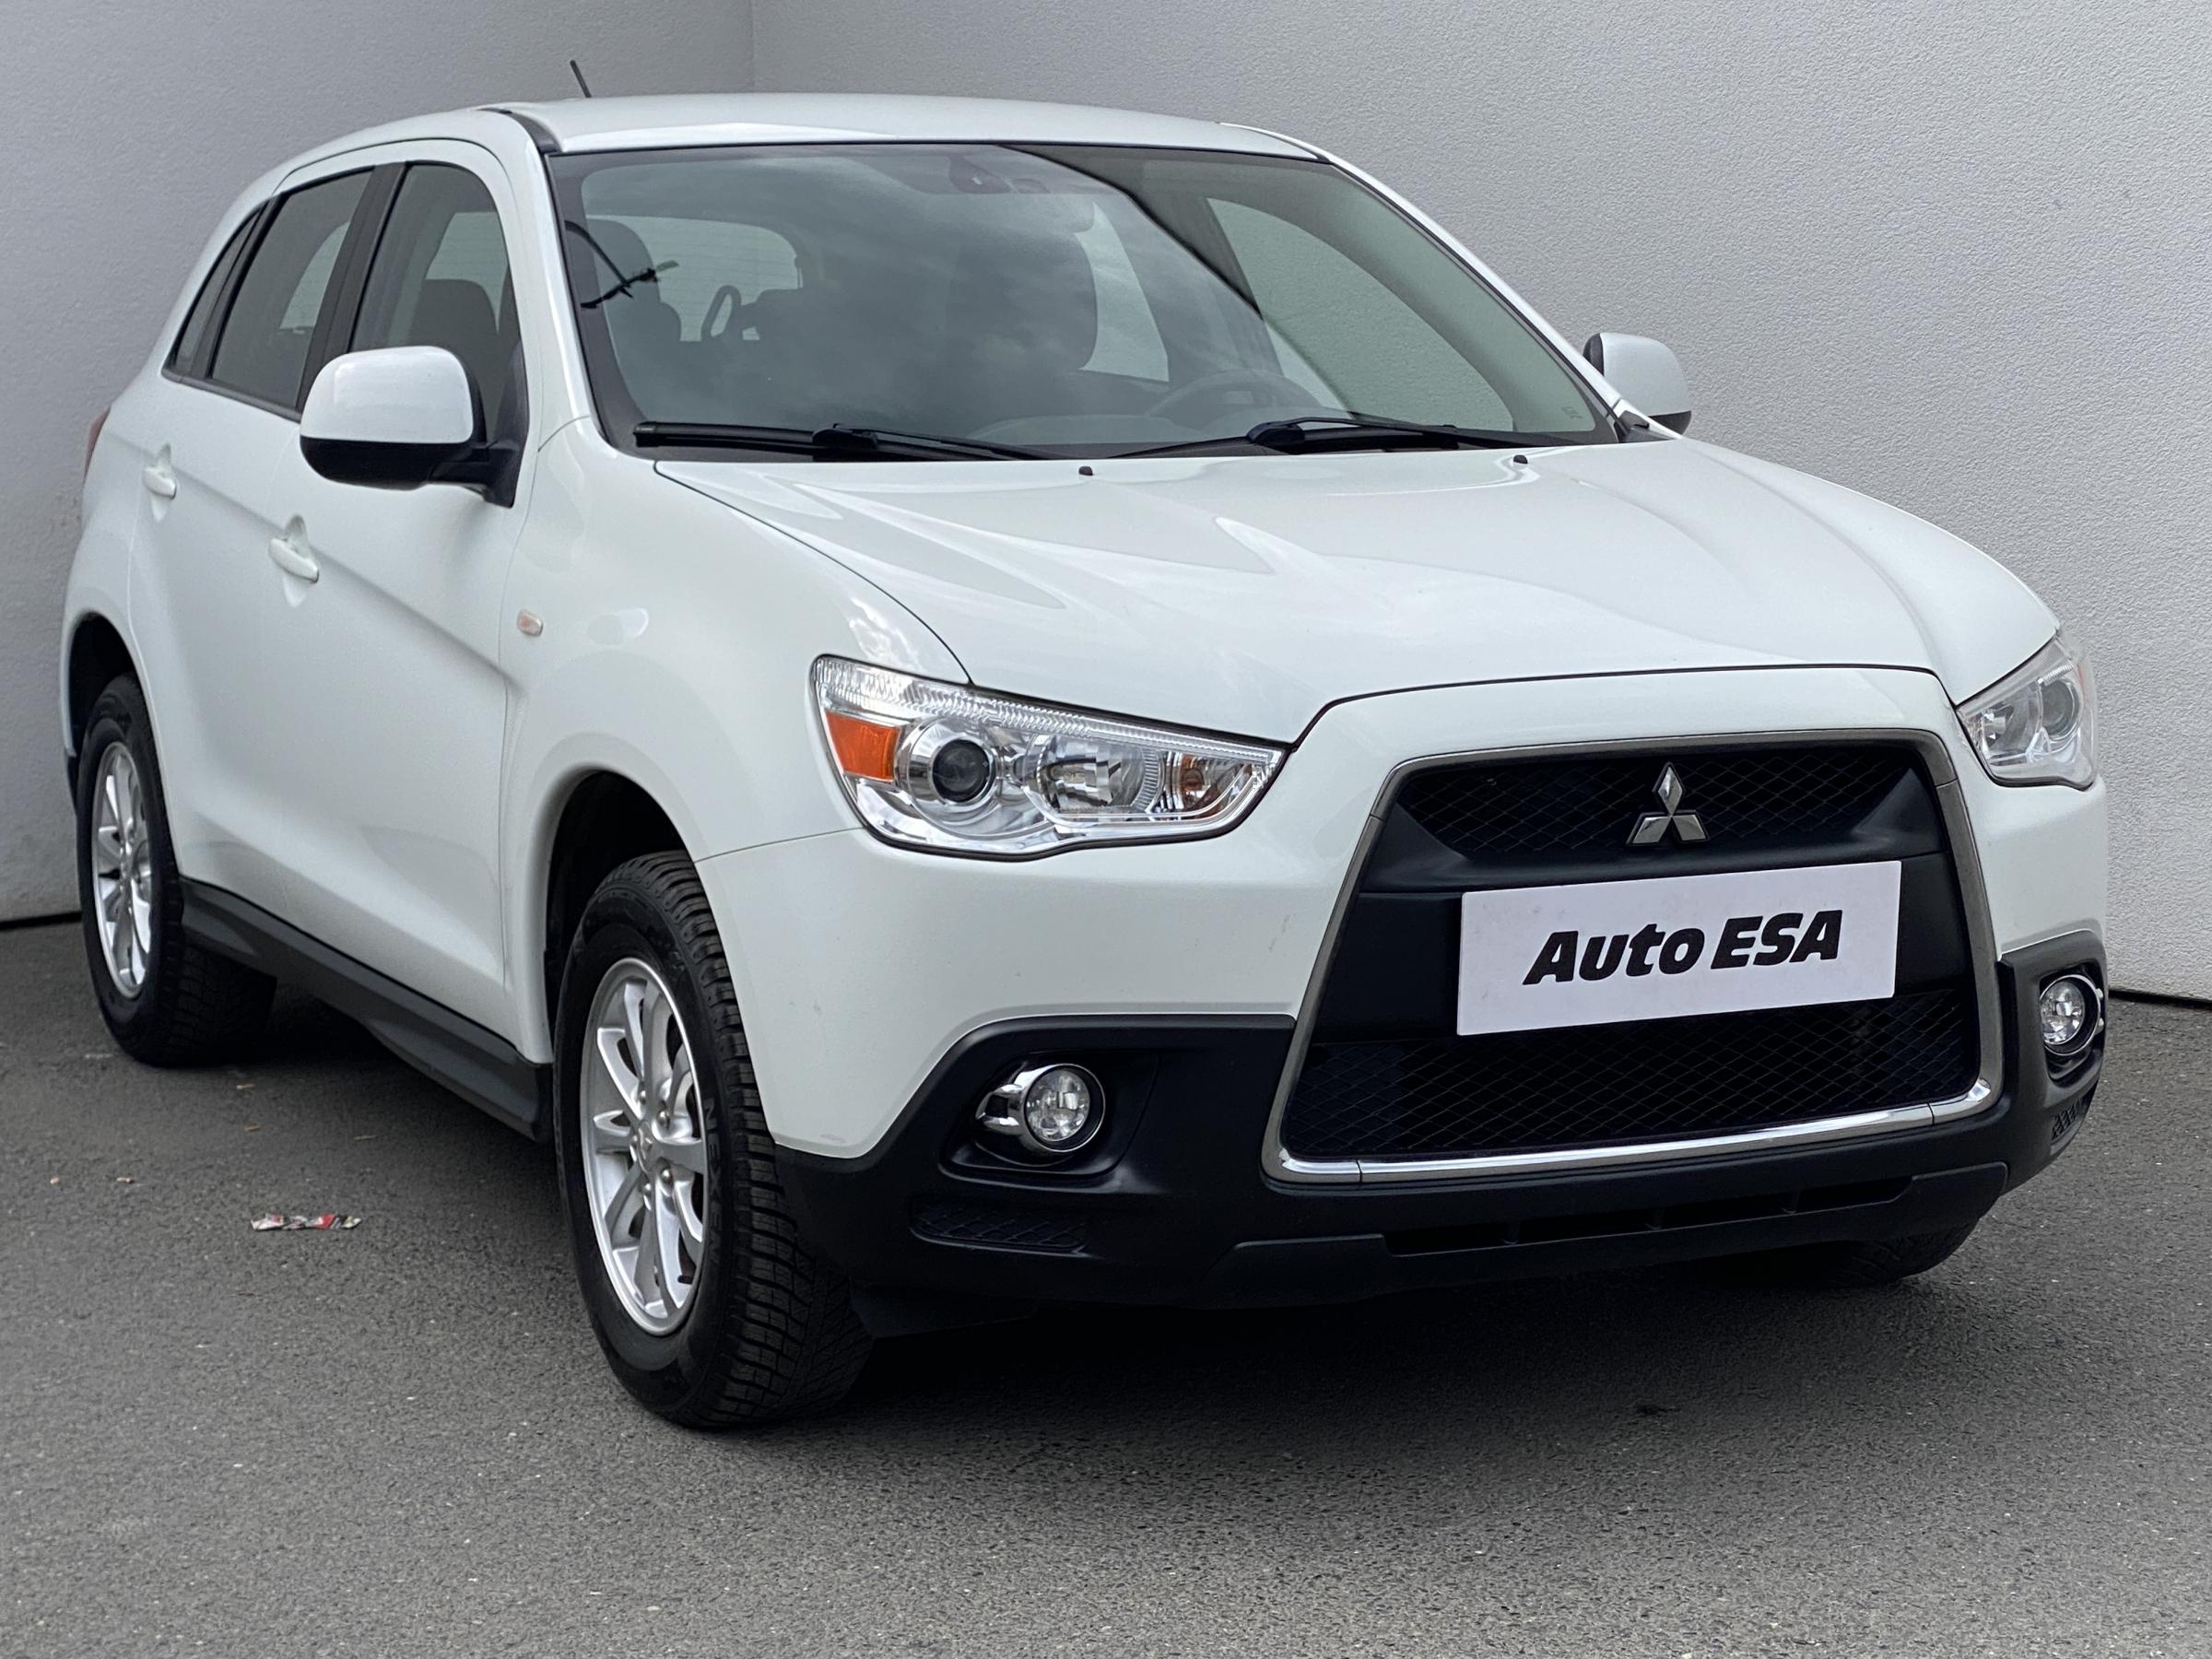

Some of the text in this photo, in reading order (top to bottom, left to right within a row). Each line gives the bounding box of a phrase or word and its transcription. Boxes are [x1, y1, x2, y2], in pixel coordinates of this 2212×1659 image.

[1522, 909, 1843, 986] Auto ESA
[704, 1098, 722, 1264] NEXEN
